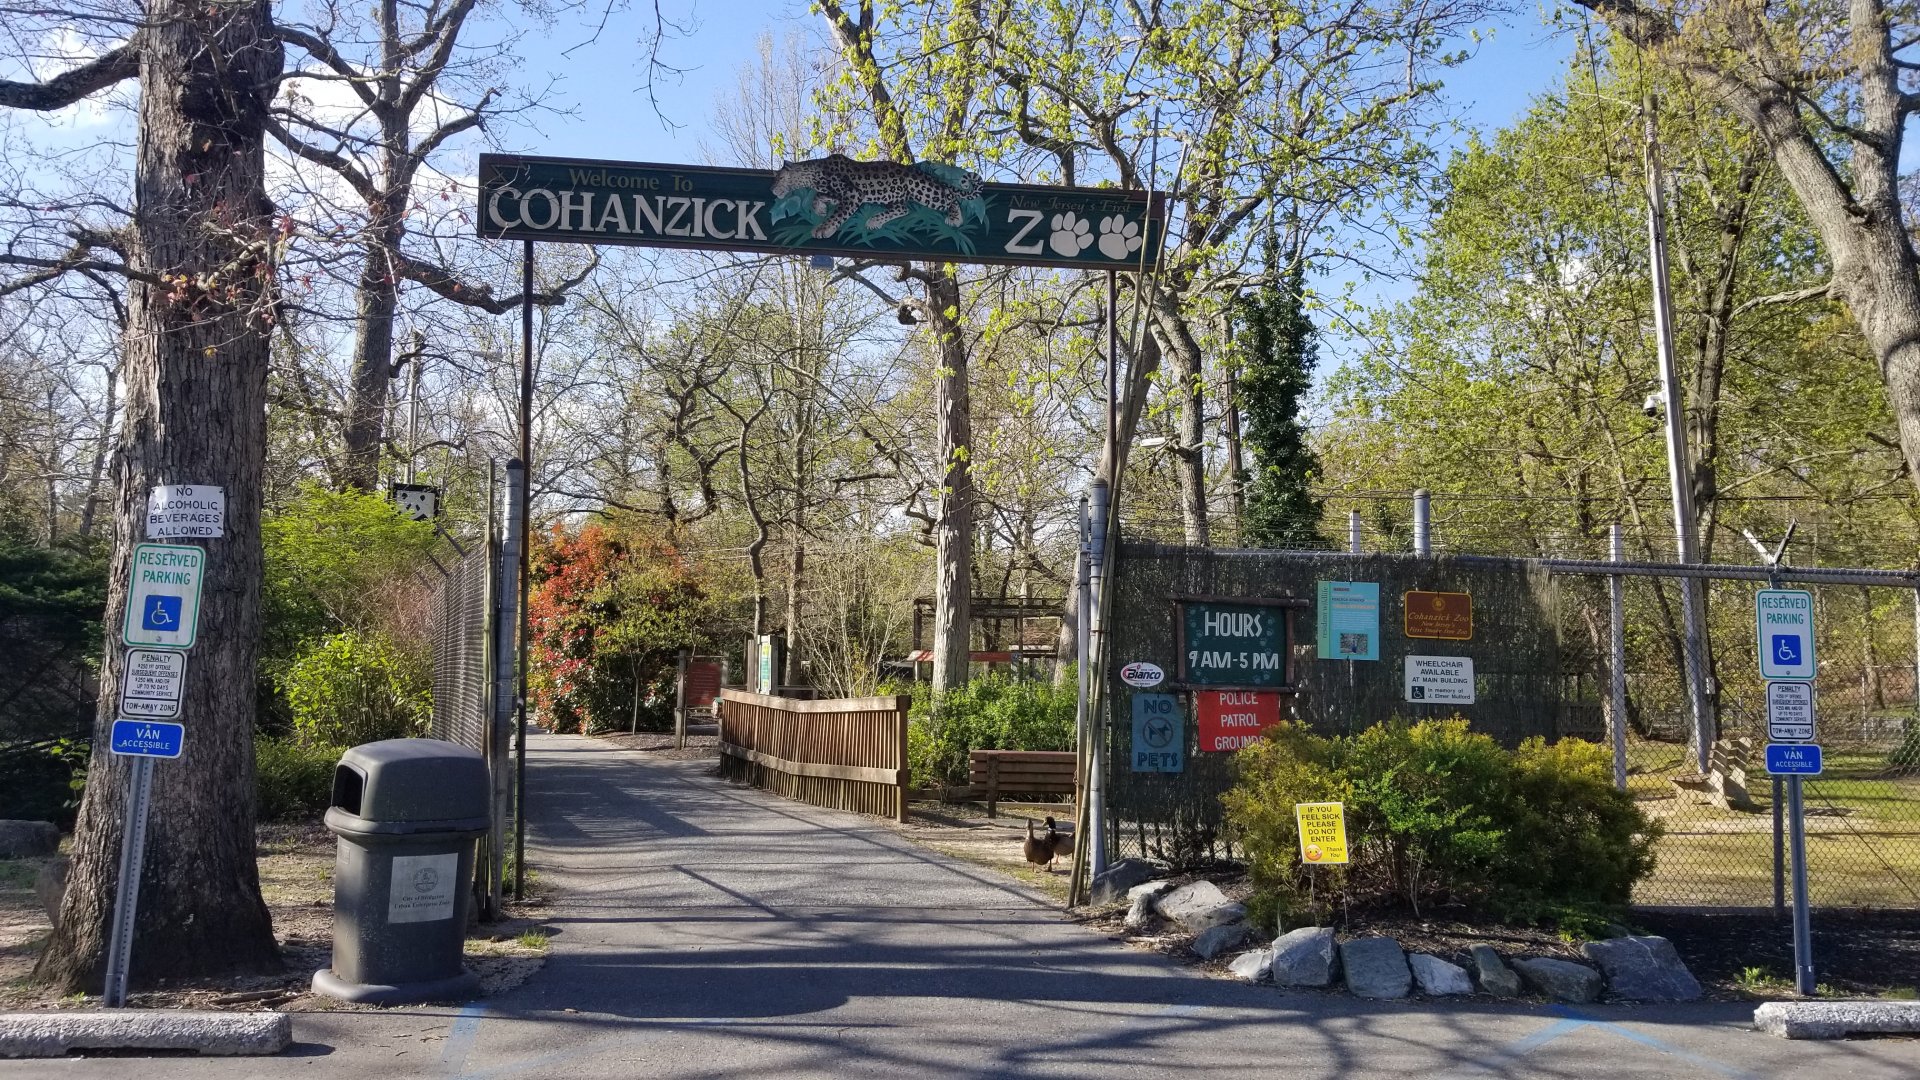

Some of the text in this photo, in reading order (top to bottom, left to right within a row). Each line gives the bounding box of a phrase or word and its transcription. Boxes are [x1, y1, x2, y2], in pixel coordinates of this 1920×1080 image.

[569, 168, 693, 192] Welcome To
[1008, 195, 1131, 214] New Jersey's First
[488, 187, 767, 241] COHANZICK
[176, 487, 193, 496] NO
[153, 500, 218, 511] ALCOHOLIC
[150, 513, 220, 524] BEVERAGES
[157, 526, 213, 536] ALLOWED
[139, 552, 198, 567] RESERVED
[142, 570, 191, 585] PARKING
[1762, 597, 1807, 609] RESERVED
[1408, 612, 1469, 622] Cohanzick Zoo
[1766, 613, 1804, 624] PARKING
[1204, 611, 1263, 637] HOURS
[141, 654, 172, 663] PENALTY
[1252, 652, 1279, 670] PM
[1415, 660, 1463, 668] WHEELCHAIR
[1125, 668, 1161, 680] Bianco
[1420, 668, 1459, 676] AVAILABLE
[1777, 685, 1801, 693] PENALTY
[1219, 692, 1259, 706] POLICE
[125, 702, 176, 712] TOW-AWAY ZONE
[1143, 699, 1172, 714] NO
[1220, 713, 1261, 727] PATROL
[136, 728, 160, 740] VAN
[122, 739, 170, 750] ACCESSIBLE
[1137, 752, 1178, 767] PETS
[1783, 750, 1803, 760] VAN
